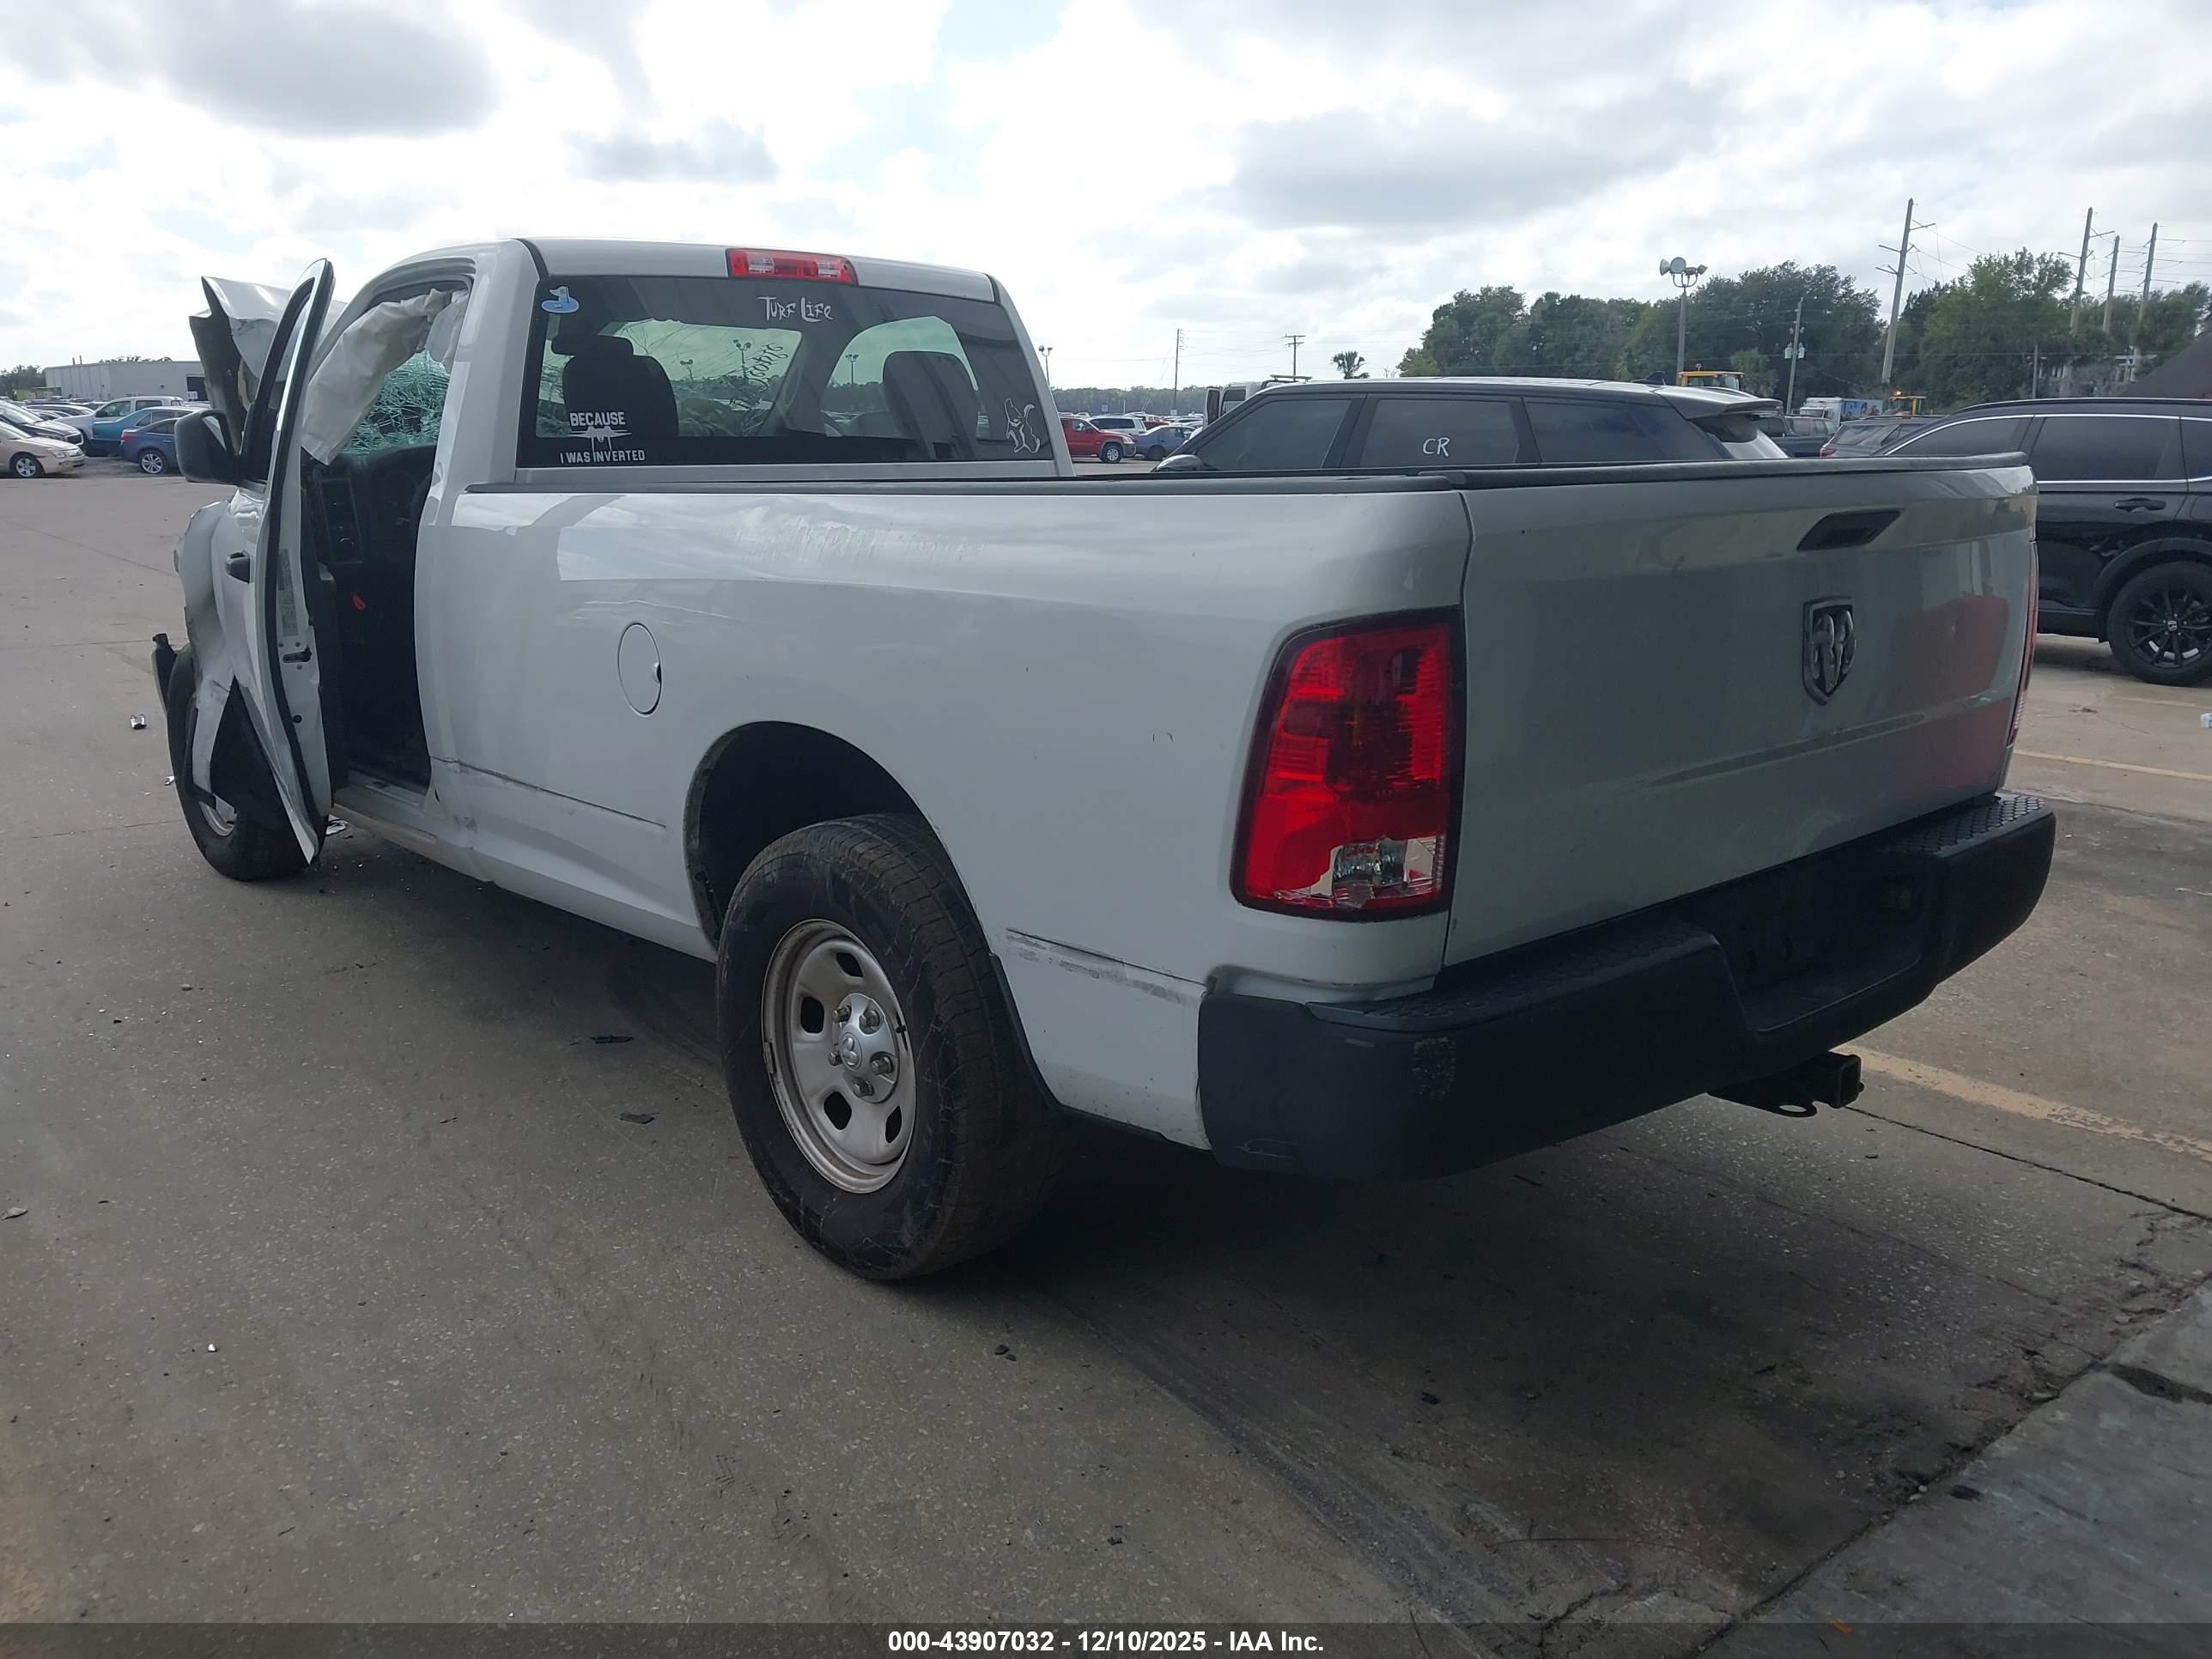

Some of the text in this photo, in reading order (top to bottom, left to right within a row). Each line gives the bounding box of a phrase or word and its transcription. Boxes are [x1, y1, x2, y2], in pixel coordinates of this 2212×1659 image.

[569, 412, 626, 427] BECAUSE
[1423, 437, 1450, 457] CR
[560, 450, 646, 464] I WAS INVERTED
